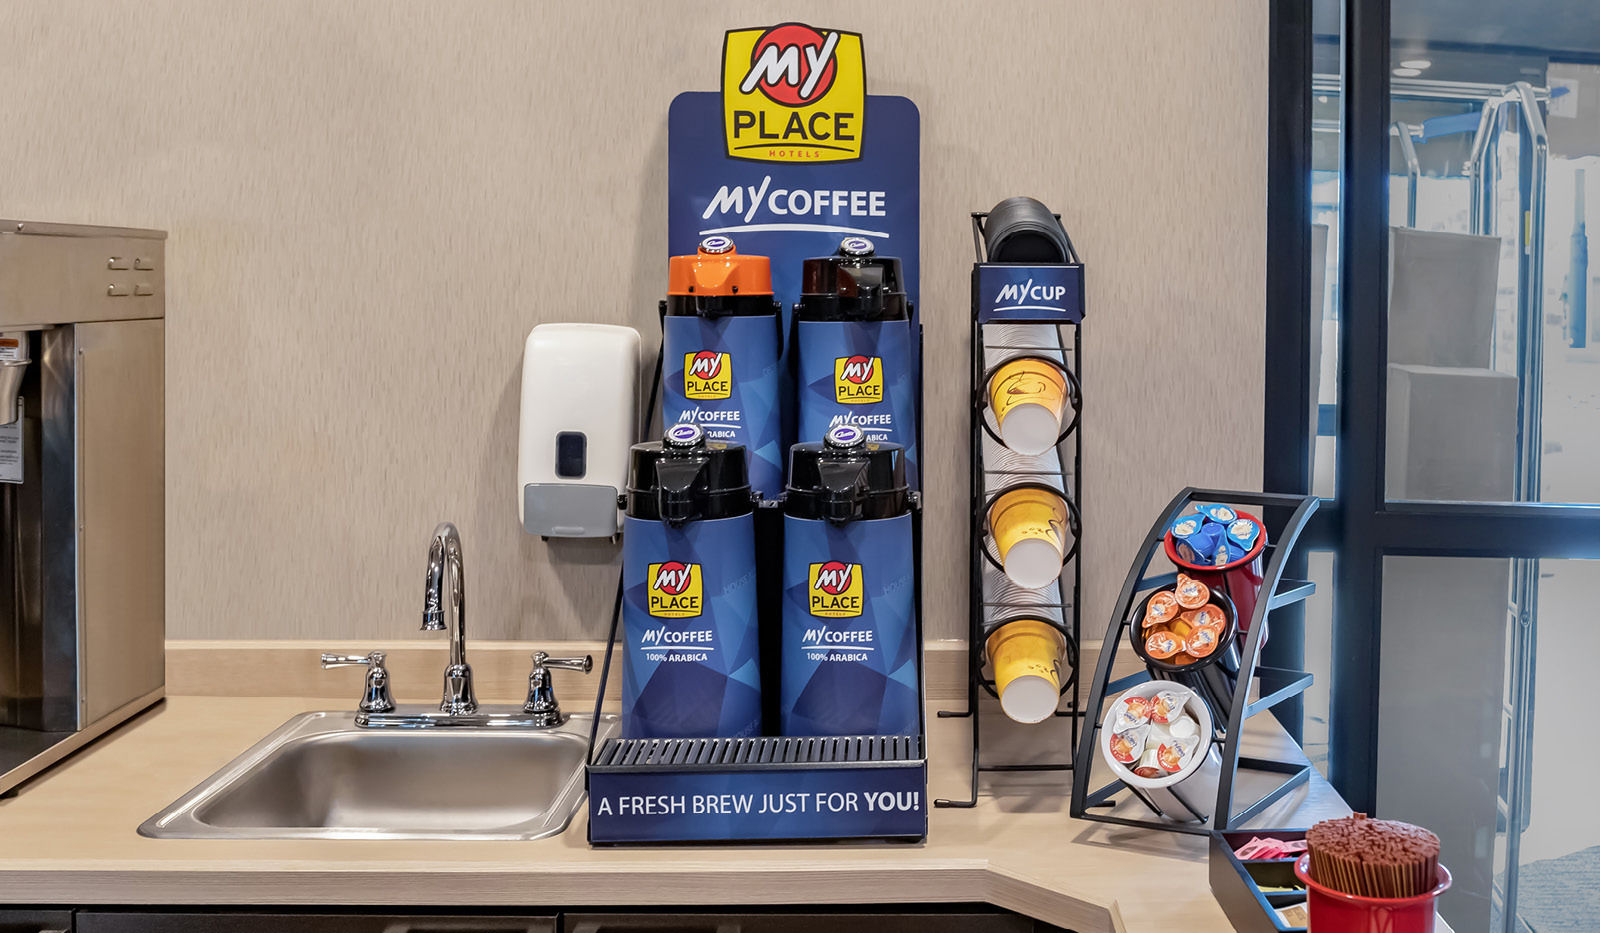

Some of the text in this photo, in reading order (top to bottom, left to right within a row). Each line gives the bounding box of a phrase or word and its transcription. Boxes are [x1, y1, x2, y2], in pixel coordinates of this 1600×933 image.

[733, 110, 855, 141] PLACE
[768, 150, 820, 158] HOTELS
[687, 381, 729, 392] PLACE
[838, 385, 881, 397] PLACE
[651, 596, 699, 609] PLACE
[812, 596, 860, 609] PLACE
[646, 653, 708, 662] 100% ARABICA
[807, 652, 868, 662] 100% ARABICA
[597, 791, 920, 816] A FRESH BREW JUST FOR YOU!
